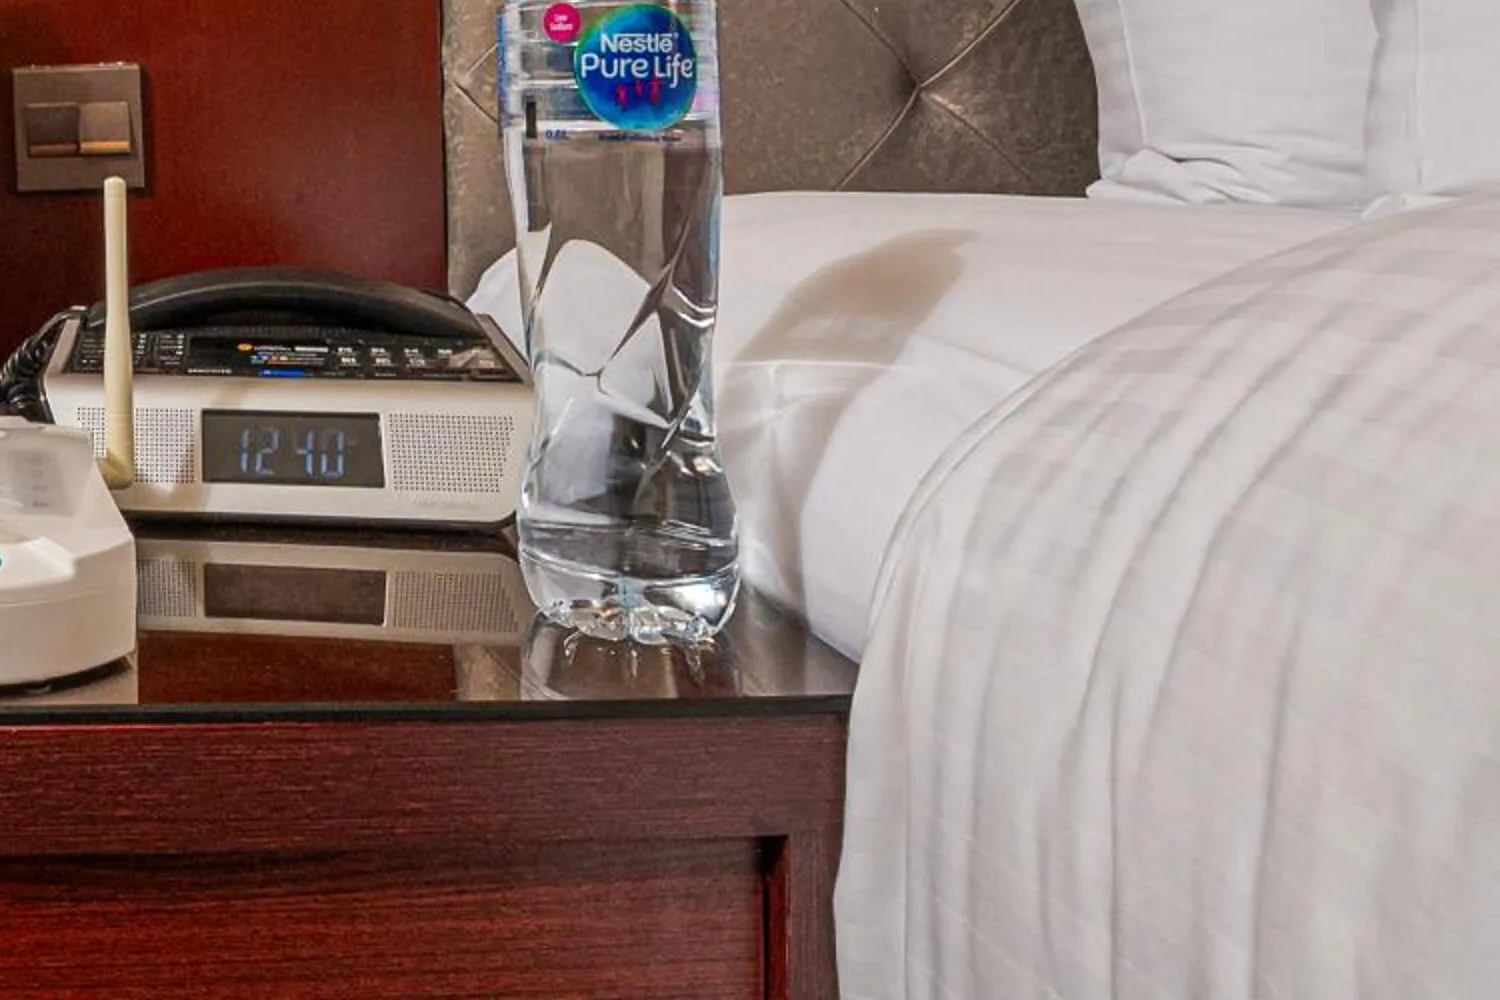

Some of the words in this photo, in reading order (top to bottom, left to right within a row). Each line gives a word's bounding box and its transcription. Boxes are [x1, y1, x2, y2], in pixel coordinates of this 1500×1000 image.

[599, 31, 674, 54] Nestlé
[580, 52, 650, 79] Pure
[653, 52, 694, 89] Life
